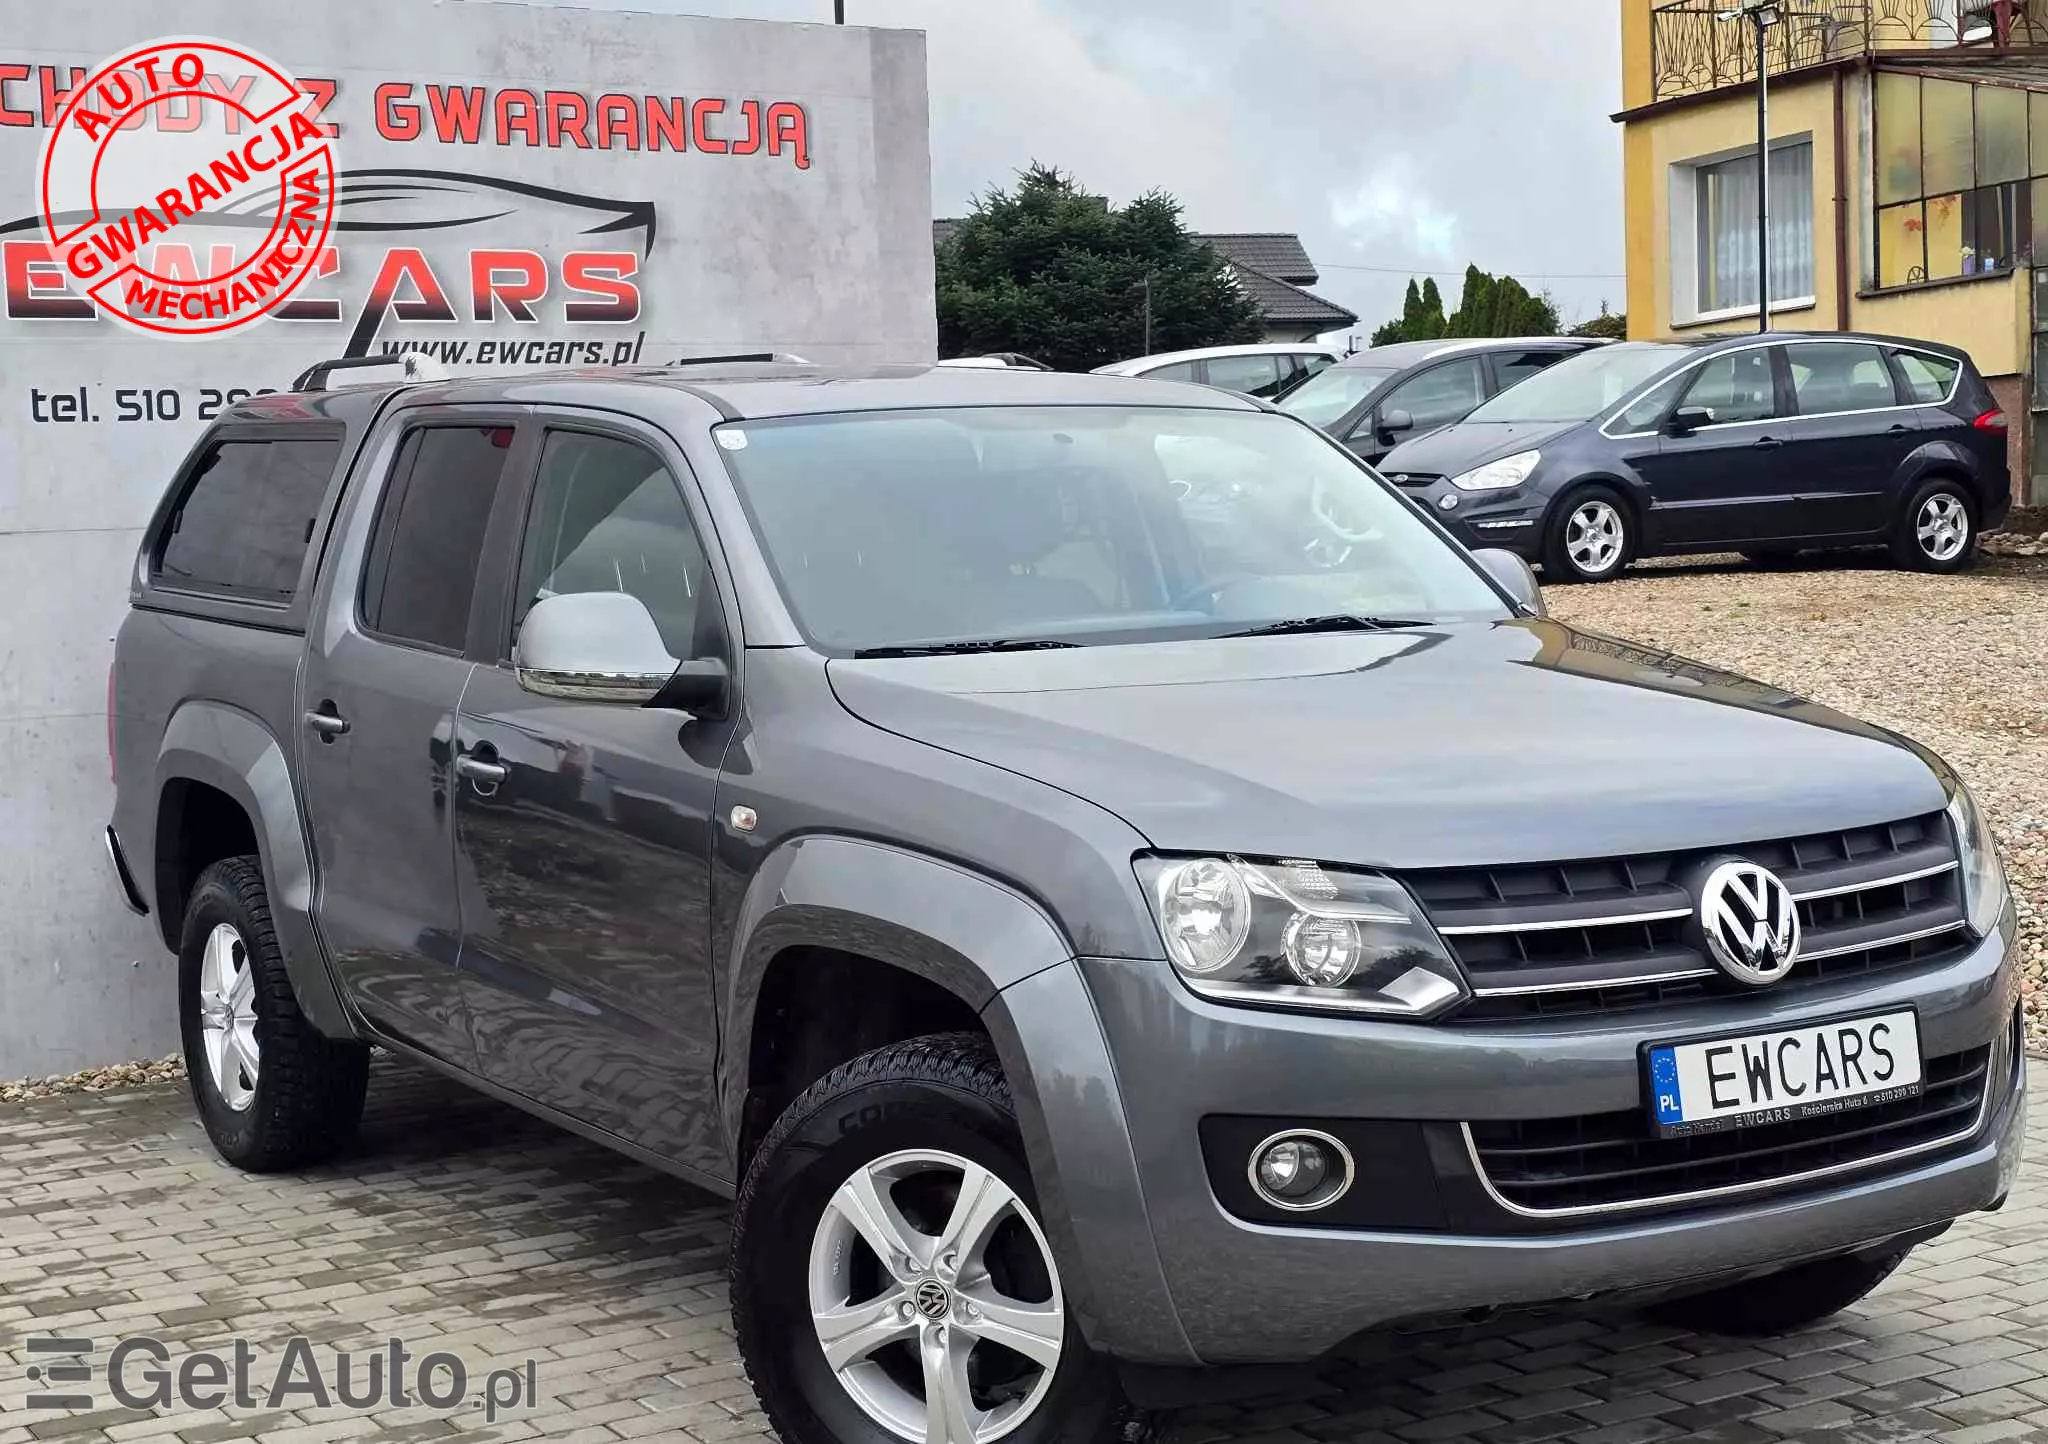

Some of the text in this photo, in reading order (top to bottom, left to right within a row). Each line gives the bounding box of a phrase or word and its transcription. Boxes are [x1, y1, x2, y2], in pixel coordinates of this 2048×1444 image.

[374, 82, 811, 170] GWARANCJĄ
[2, 239, 642, 358] EWCARS
[31, 387, 100, 422] tel.
[116, 388, 181, 422] 510
[1704, 1022, 1895, 1110] EWCARS
[1659, 1094, 1680, 1113] PL
[1735, 1107, 1792, 1128] EWCARS
